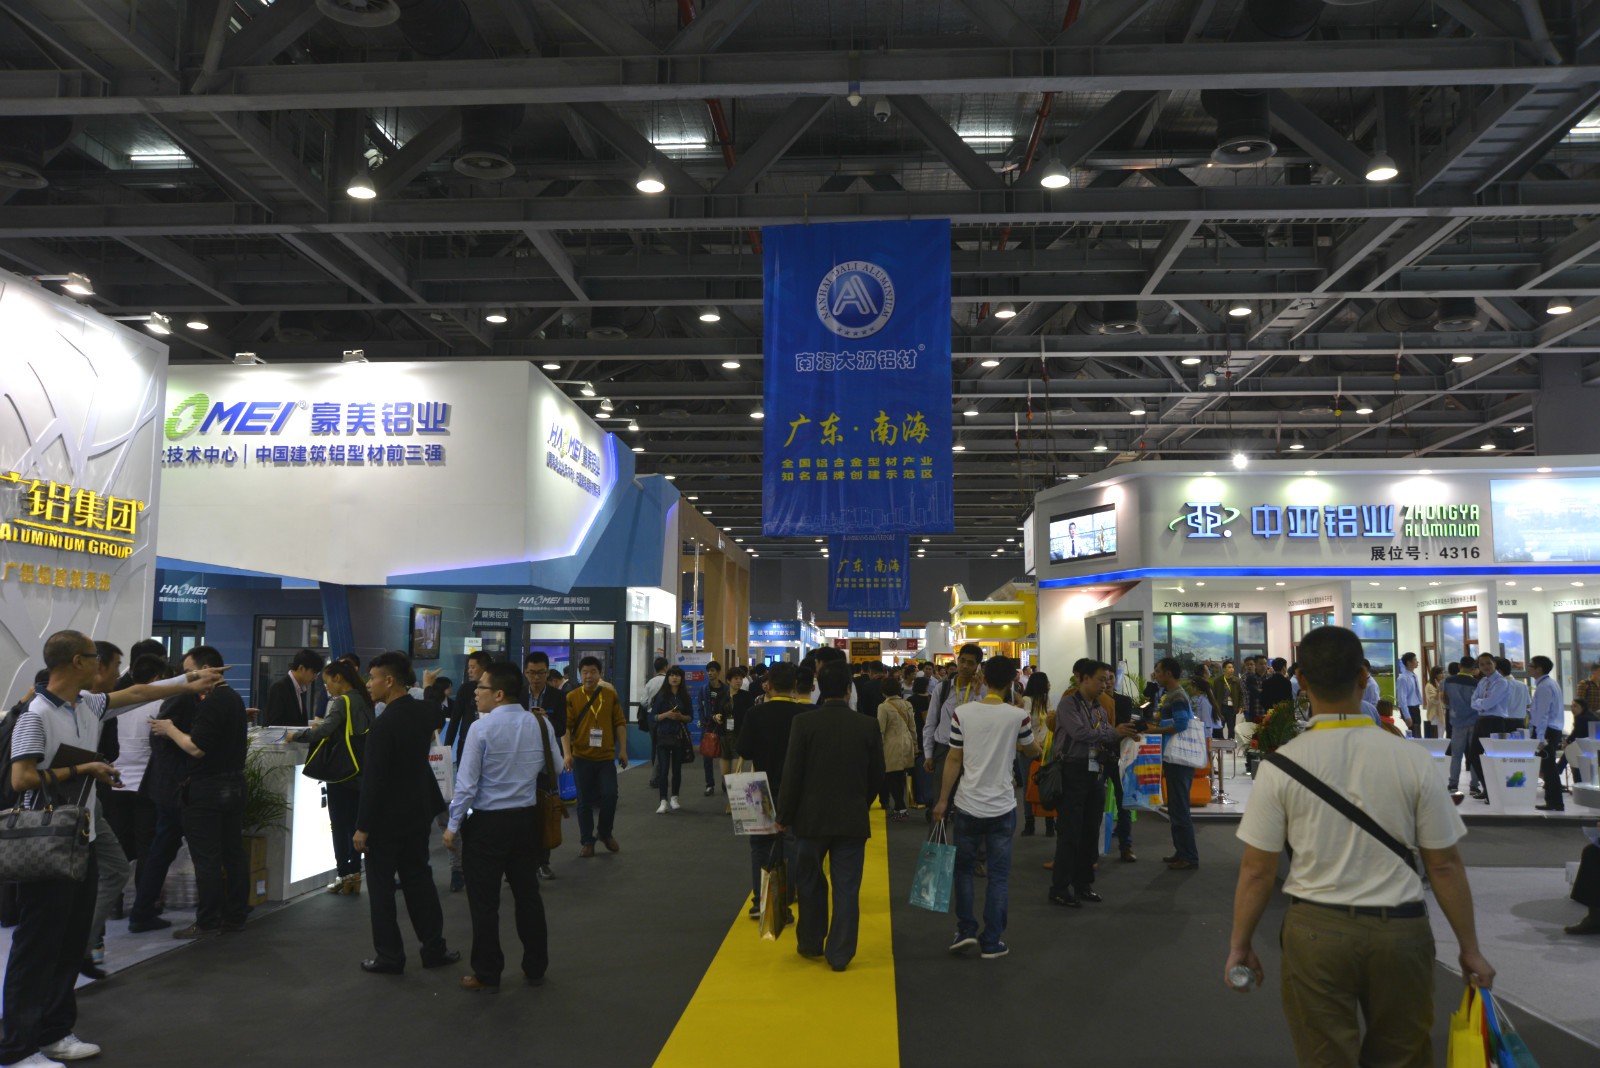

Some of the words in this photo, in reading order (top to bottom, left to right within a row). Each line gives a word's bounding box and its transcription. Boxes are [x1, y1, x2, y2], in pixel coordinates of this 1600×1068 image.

[819, 278, 832, 320] NANHAI
[862, 264, 893, 318] ALUMINIUM
[796, 350, 917, 372] 南海大沥铝材
[311, 401, 448, 434] 豪美铝业
[255, 444, 442, 463] 中国建筑铝型材前三强
[781, 456, 933, 469] 全国铝合金型材产业
[781, 469, 933, 481] 知名品牌创建示范区
[1251, 504, 1396, 539] 中亚铝业
[1403, 504, 1480, 520] ZHONGYA
[1405, 523, 1480, 538] ALUMINUM
[88, 540, 133, 559] GROUP
[1439, 547, 1480, 559] 4316
